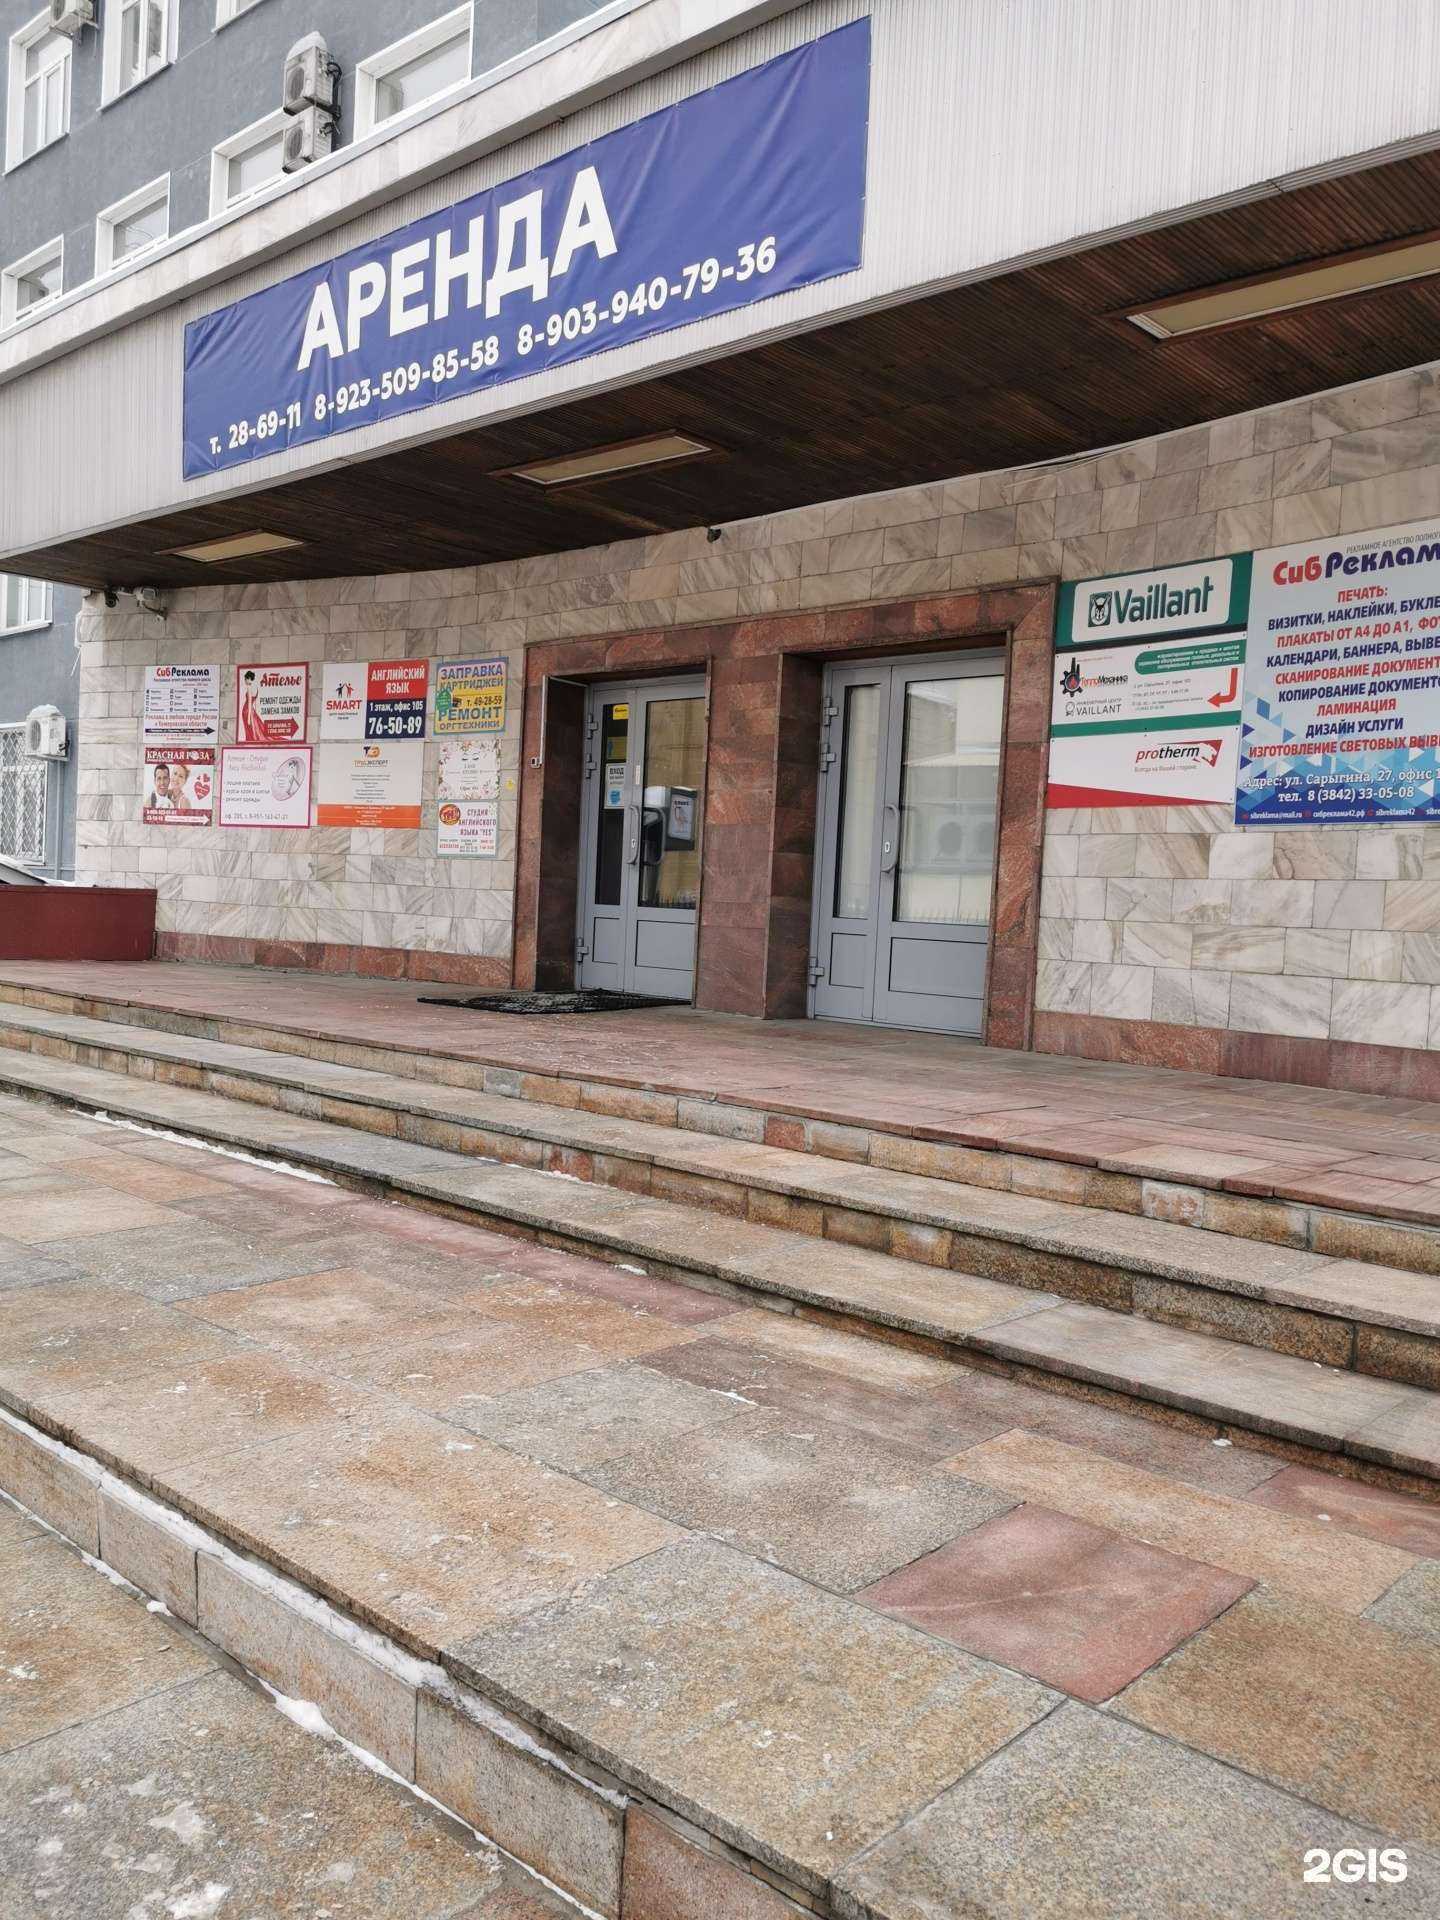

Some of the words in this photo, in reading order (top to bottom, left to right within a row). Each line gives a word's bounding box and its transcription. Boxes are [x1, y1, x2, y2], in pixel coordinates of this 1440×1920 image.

[298, 166, 617, 371] АРЕНДА
[209, 437, 221, 455] т.
[229, 402, 301, 449] 28-69-11
[314, 336, 499, 420] 8-923-509-85-58
[517, 237, 776, 355] 8-903-940-79-36
[1346, 540, 1381, 554] РЕКЛАМНОЕ
[1382, 535, 1414, 548] АГЕНТСТВО
[1115, 576, 1214, 624] Vaillant
[1337, 586, 1388, 603] ПЕЧАТЬ:
[1268, 613, 1325, 631] ВИЗИТКИ,
[1327, 602, 1398, 624] НАКЛЕЙКИ,
[1277, 630, 1334, 648] ПЛАКАТЫ
[1337, 627, 1353, 641] ОТ
[1373, 622, 1391, 639] ДО
[1267, 648, 1341, 668] КАЛЕНДАРИ,
[1343, 640, 1403, 659] БАННЕРА,
[157, 667, 209, 677] СибРеклама
[260, 672, 302, 687] Ателье
[371, 664, 425, 681] АНГЛИЙСКИЙ
[440, 664, 503, 680] ЗАПРАВКА
[1275, 663, 1369, 685] СКАНИРОВАНИЕ
[385, 682, 410, 694] ЯЗЫК
[1278, 682, 1366, 703] КОПИРОВАНИЕ
[260, 696, 278, 705] РЕМОНТ
[279, 696, 302, 705] ОДЕЖДЫ
[326, 700, 362, 710] SMART
[370, 702, 373, 711] 1
[374, 703, 393, 712] этаж,
[394, 702, 411, 713] офис
[412, 701, 424, 711] 105
[474, 695, 503, 706] 49-28-59
[1316, 697, 1396, 717] ЛАМИНАЦИЯ
[439, 706, 503, 722] РЕМОНТ
[1077, 704, 1121, 715] VAILLANT
[369, 716, 422, 735] 76-50-89
[440, 721, 500, 730] ОРГТЕХНИКИ
[1306, 719, 1355, 739] ДИЗАЙН
[1357, 717, 1404, 733] УСЛУГИ
[147, 751, 184, 760] КРАСНАЯ
[1136, 746, 1199, 763] protherm
[1249, 740, 1337, 758] ИЗГОТОВЛЕНИЕ
[1339, 736, 1406, 753] СВЕТОВЫХ
[1244, 774, 1283, 792] Адрес:
[1285, 776, 1302, 788] ул.
[1306, 771, 1374, 787] Сарыгина,
[1377, 769, 1396, 783] 27,
[1399, 768, 1432, 783] офис
[1278, 790, 1302, 802] тел.
[1308, 790, 1315, 801] 8
[1317, 787, 1356, 804] (3842)
[1358, 786, 1415, 800] 33-05-08
[467, 808, 488, 817] СТУДИЯ
